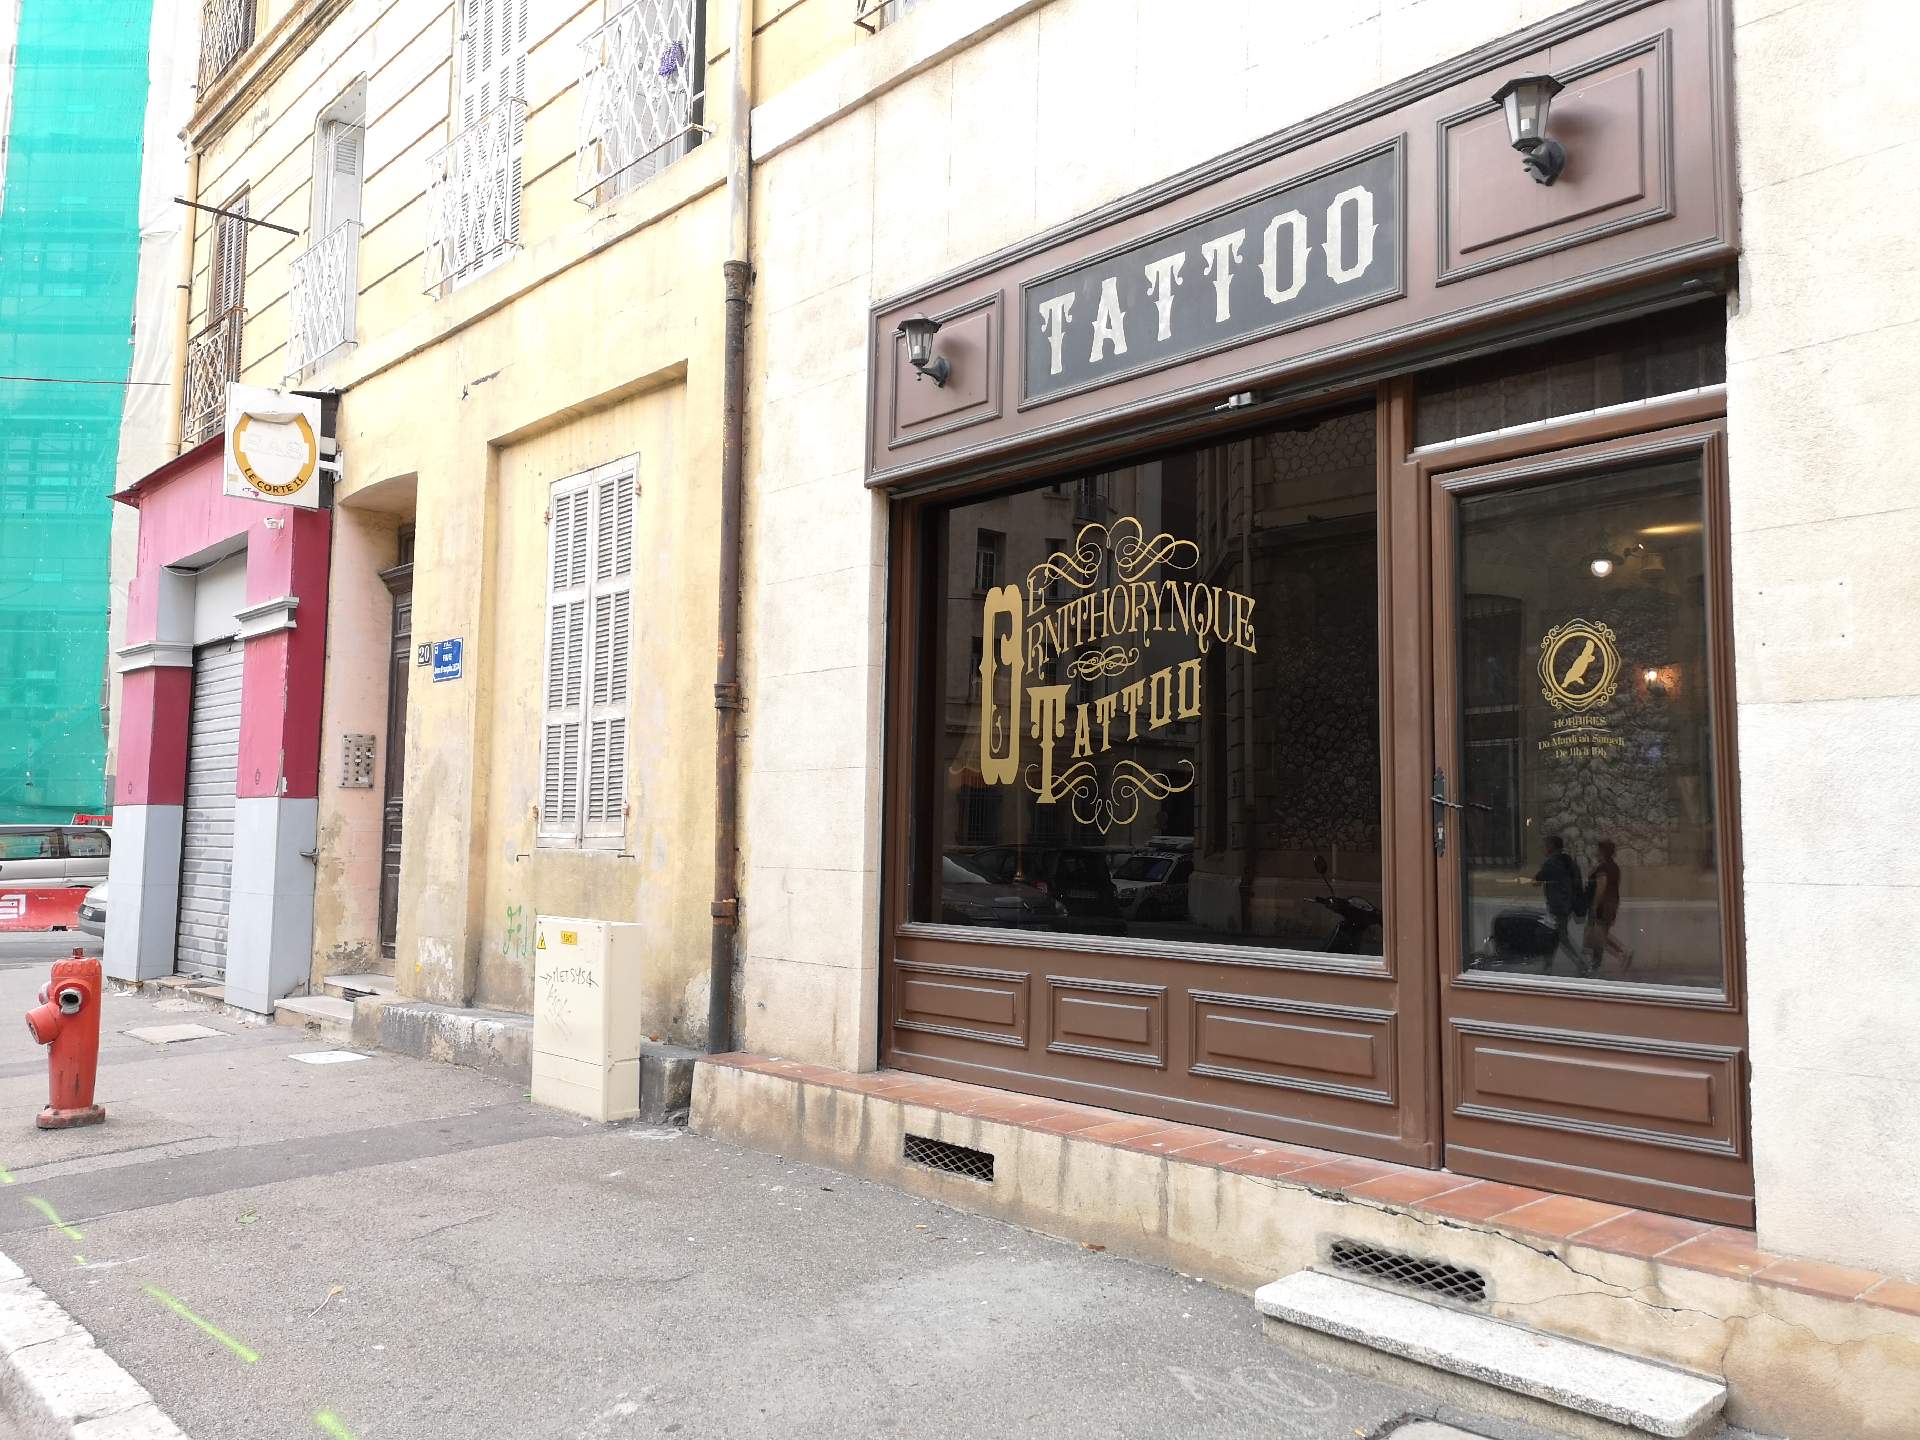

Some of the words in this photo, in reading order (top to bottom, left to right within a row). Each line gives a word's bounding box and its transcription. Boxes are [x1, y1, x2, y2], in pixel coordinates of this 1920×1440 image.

[1038, 184, 1379, 375] TATTOO
[244, 467, 257, 481] LE
[418, 645, 430, 663] 20
[1025, 657, 1202, 805] TATTOO
